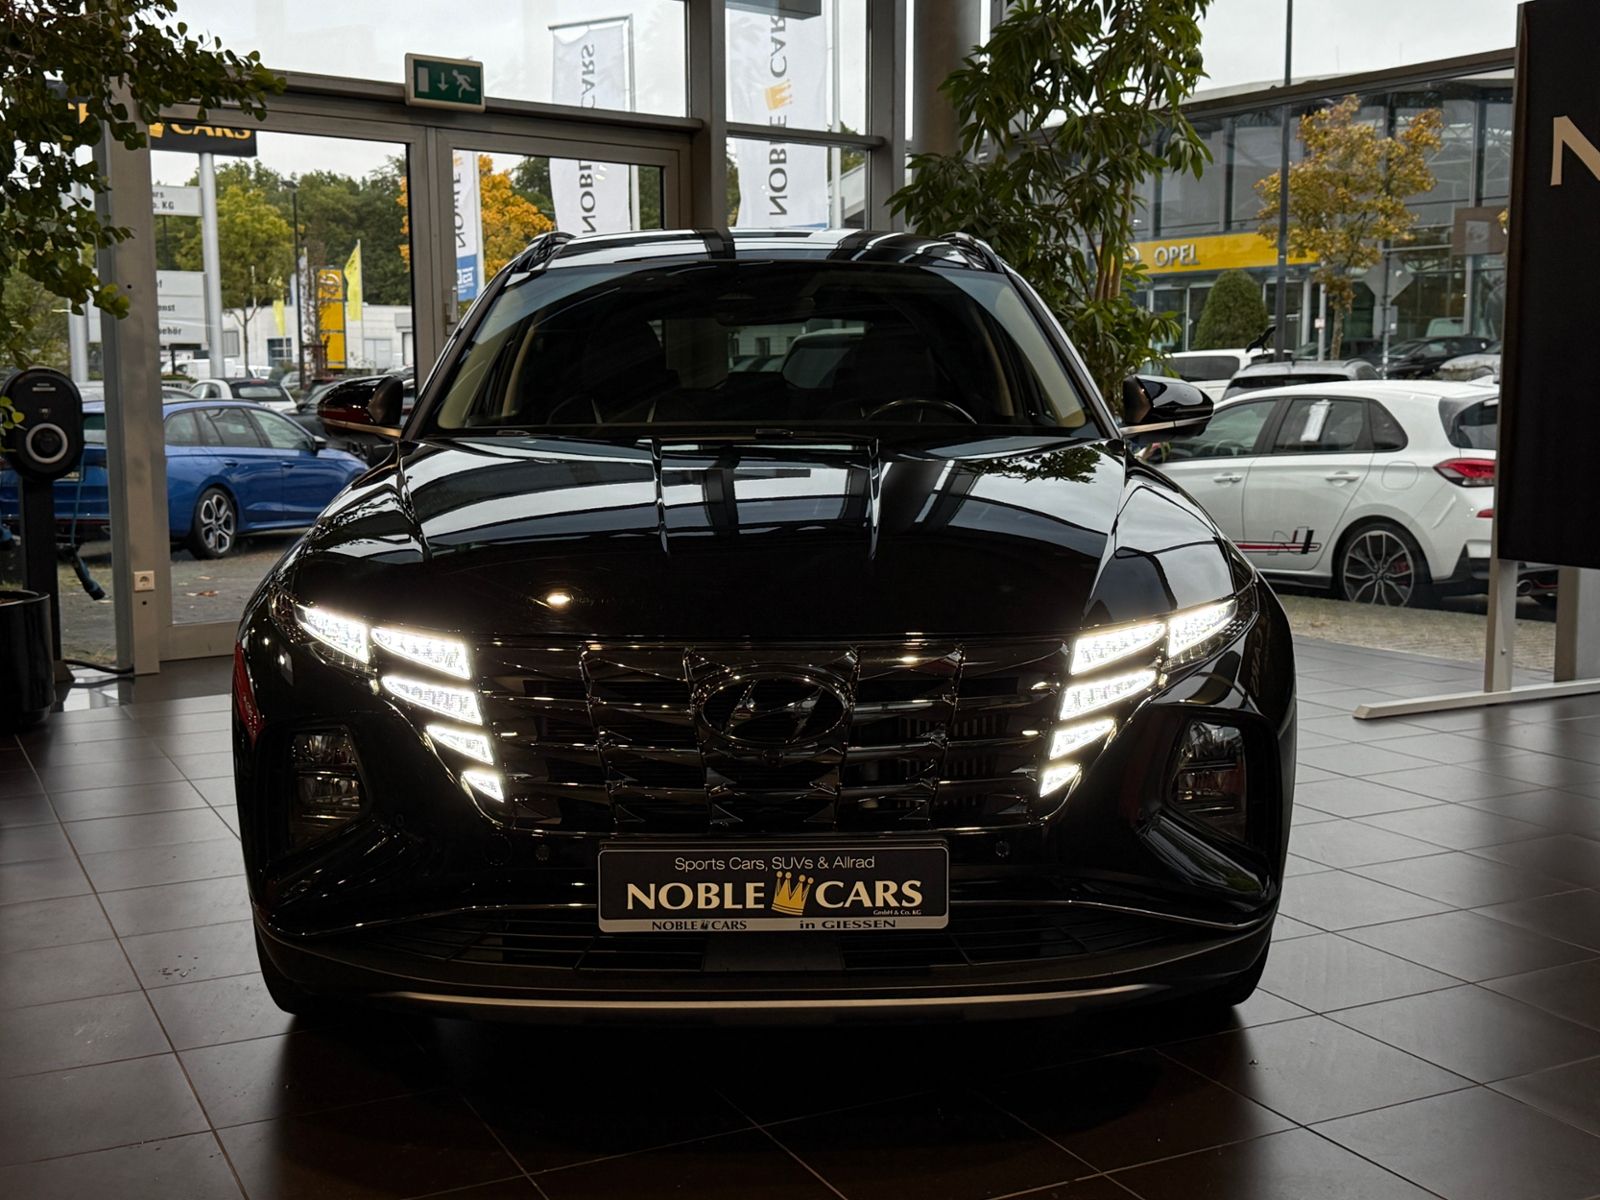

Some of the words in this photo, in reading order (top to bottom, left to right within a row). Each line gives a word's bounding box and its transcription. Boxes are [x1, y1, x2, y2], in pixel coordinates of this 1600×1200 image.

[1154, 243, 1200, 267] OPEL
[674, 856, 726, 873] Sports
[729, 856, 769, 872] Cars,
[771, 856, 814, 870] SUVs
[817, 856, 830, 869] &
[833, 855, 876, 869] Allrad
[626, 882, 765, 910] NOBLE
[815, 880, 923, 909] CARS
[651, 920, 698, 931] NOBLE
[711, 920, 747, 930] CARS
[800, 920, 815, 929] in
[822, 919, 897, 929] GIESSEN
